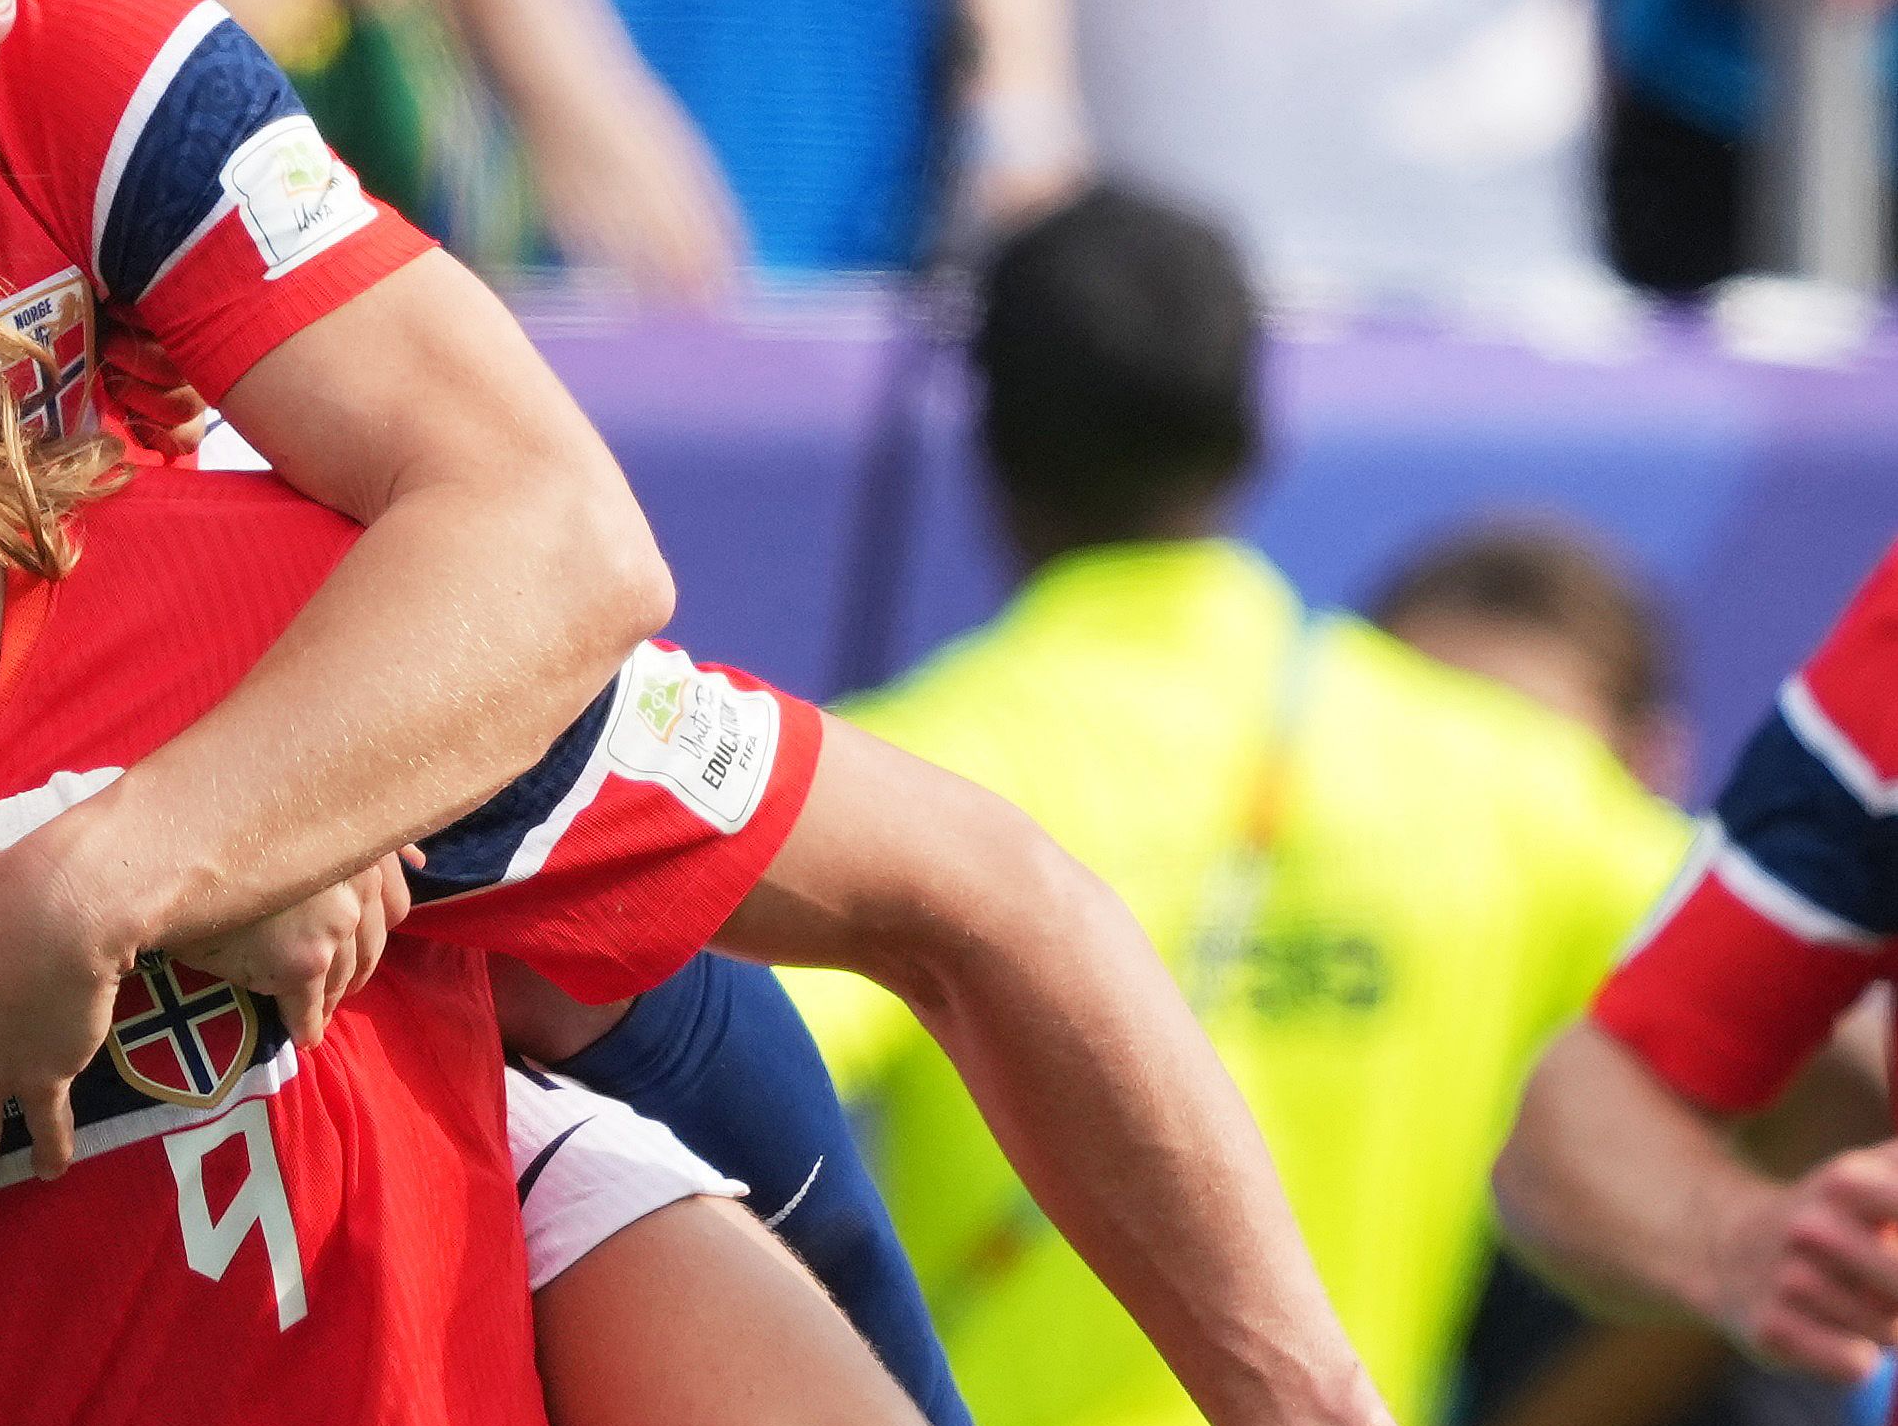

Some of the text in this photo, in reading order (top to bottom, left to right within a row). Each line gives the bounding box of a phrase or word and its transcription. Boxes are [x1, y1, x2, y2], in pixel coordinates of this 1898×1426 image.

[12, 297, 54, 331] NORGE
[739, 734, 758, 771] FIFA
[162, 1098, 310, 1334] 9
